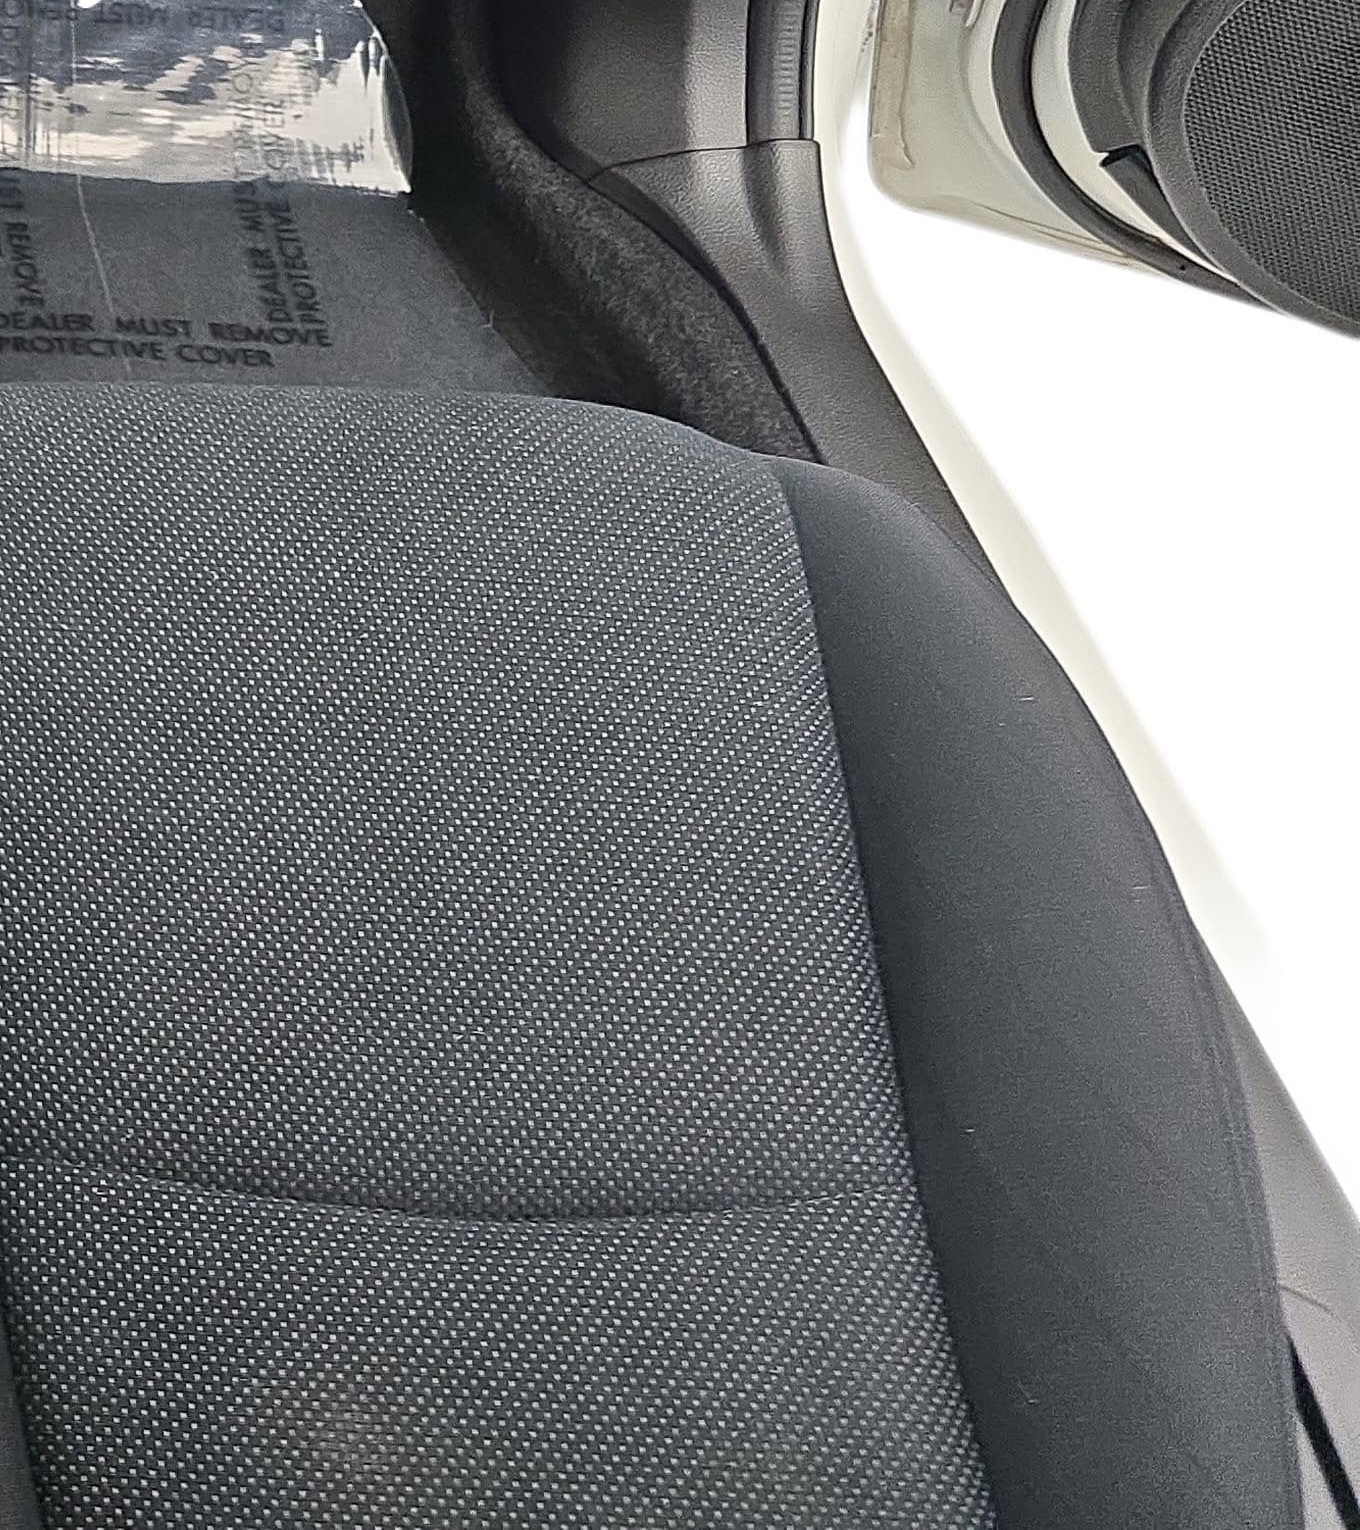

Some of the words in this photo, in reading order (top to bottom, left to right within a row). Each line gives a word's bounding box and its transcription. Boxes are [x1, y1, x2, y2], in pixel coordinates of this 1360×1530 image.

[4, 221, 46, 310] REMOVE
[247, 245, 294, 324] DEALER
[264, 200, 326, 325] PROTECTIVE
[115, 316, 194, 338] MUST
[208, 321, 335, 348] REMOVE
[176, 343, 276, 369] COVER
